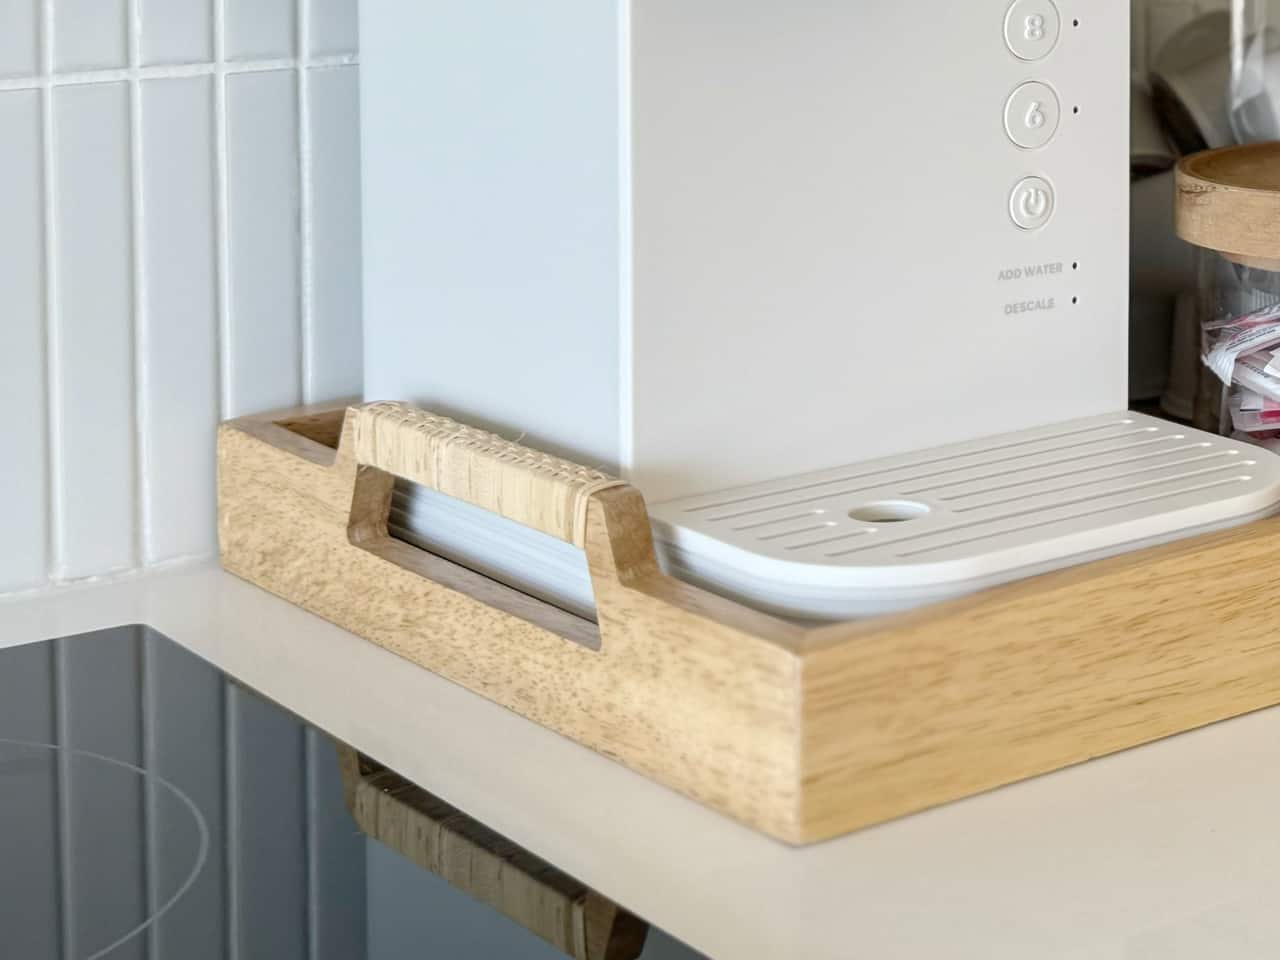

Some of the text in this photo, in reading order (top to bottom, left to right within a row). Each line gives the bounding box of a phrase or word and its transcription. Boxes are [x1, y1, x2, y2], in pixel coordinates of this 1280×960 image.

[1024, 14, 1045, 41] 8
[1024, 101, 1046, 130] 6
[998, 262, 1063, 281] ADD WATER
[1004, 297, 1056, 315] DESCALE
